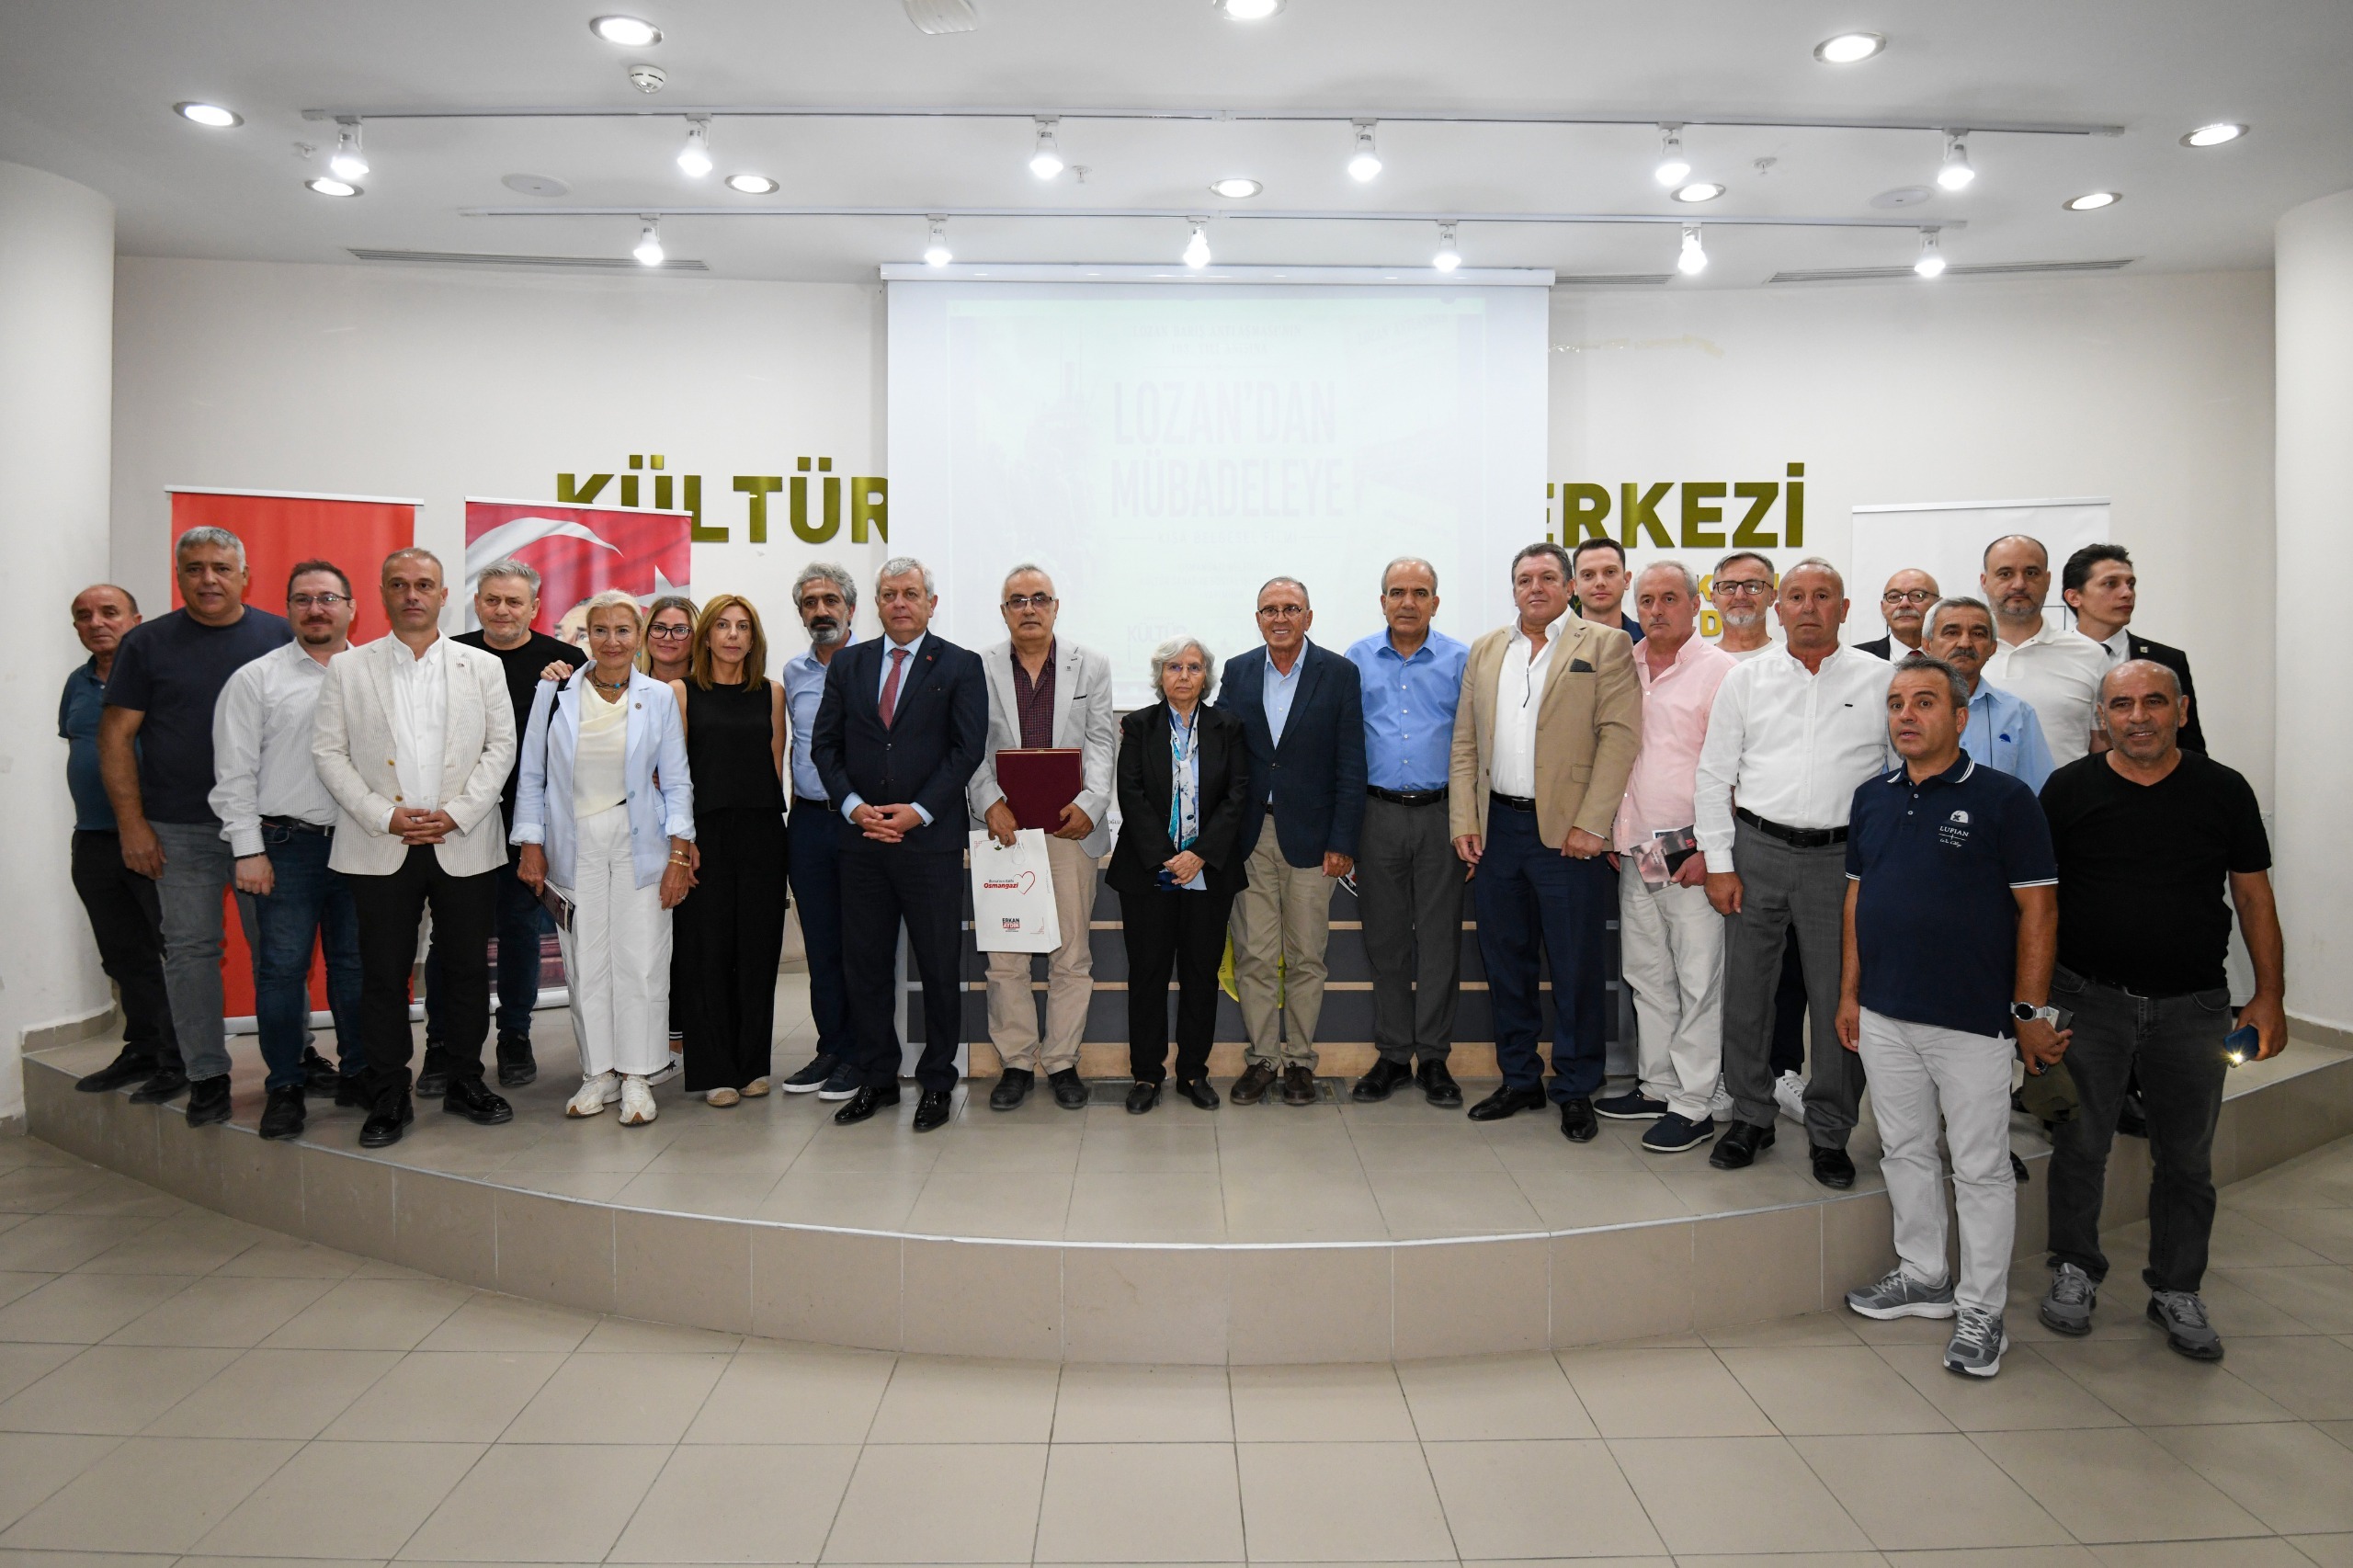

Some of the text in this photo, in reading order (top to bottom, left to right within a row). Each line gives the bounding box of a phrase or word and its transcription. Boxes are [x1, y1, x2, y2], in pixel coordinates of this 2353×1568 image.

[1114, 381, 1336, 445] LOZAN'DAN
[1111, 448, 1344, 518] MÜBADELEYE
[1547, 462, 1805, 549] RKEZİ
